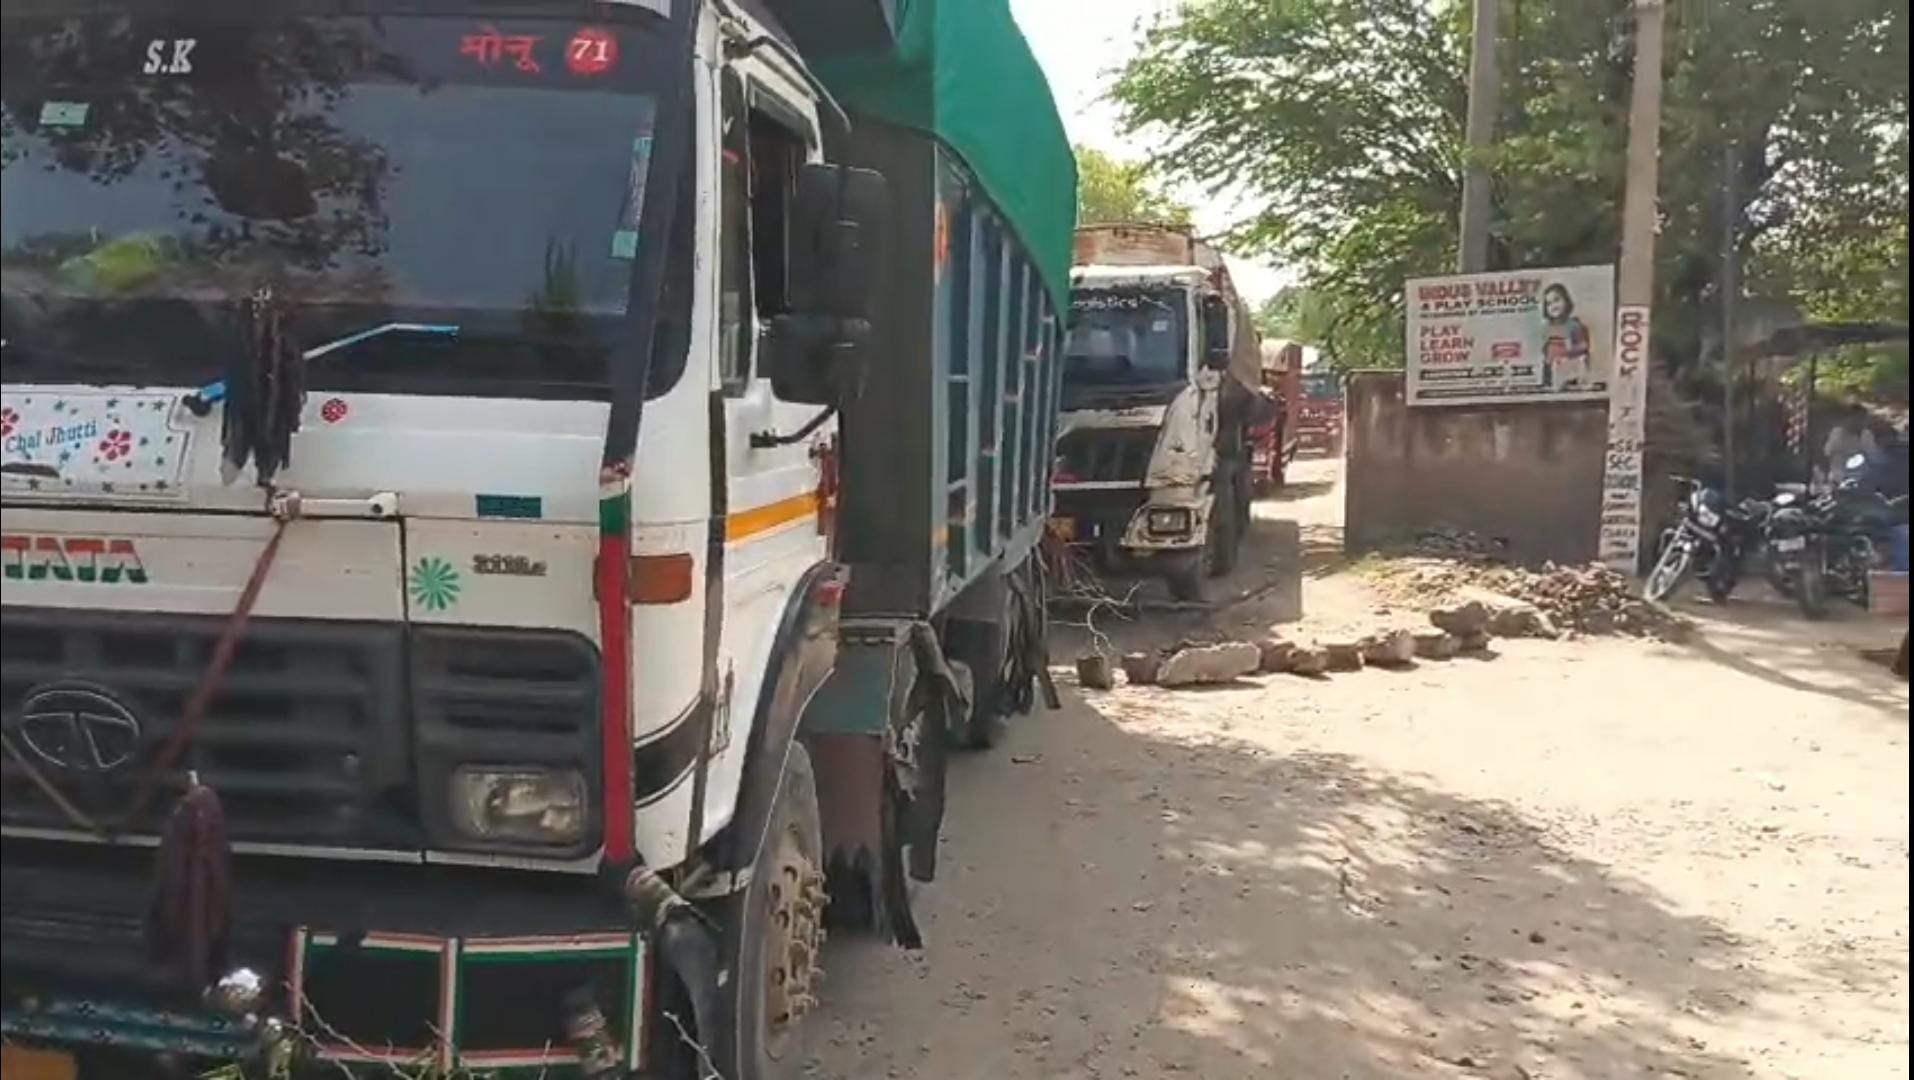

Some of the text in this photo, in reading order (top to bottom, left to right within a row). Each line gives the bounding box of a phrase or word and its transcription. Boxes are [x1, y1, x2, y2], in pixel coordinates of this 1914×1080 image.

[143, 39, 196, 75] S.K
[572, 37, 609, 63] 71
[1474, 279, 1541, 297] VALLEY
[1071, 293, 1139, 311] ogistics
[1434, 299, 1471, 310] PLAY
[1475, 295, 1539, 308] SCHOOL
[1419, 325, 1462, 338] PLAY
[1419, 337, 1475, 351] LEARN
[1420, 350, 1471, 365] GROW
[5, 421, 97, 453] Chal Jhutti
[0, 535, 147, 583] TATA
